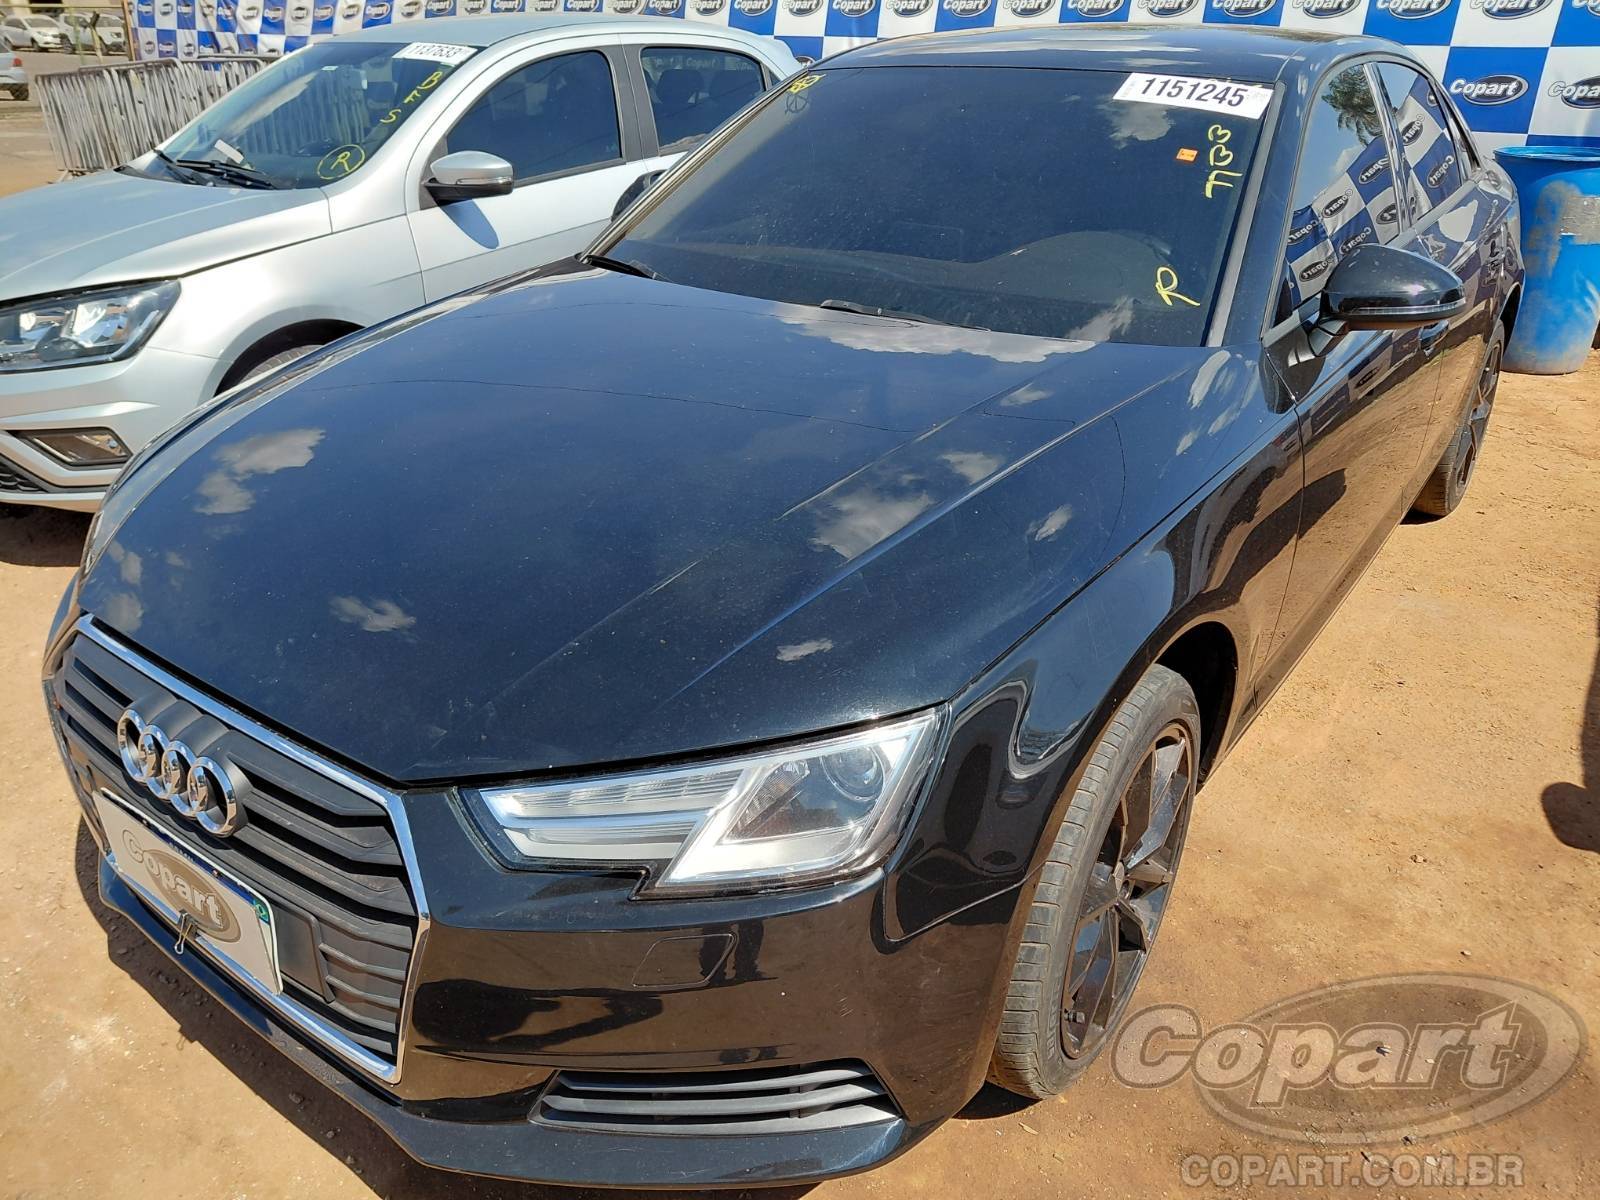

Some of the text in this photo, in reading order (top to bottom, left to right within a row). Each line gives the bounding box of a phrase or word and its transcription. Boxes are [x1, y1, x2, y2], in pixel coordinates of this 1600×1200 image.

[1141, 78, 1248, 107] 1151245
[1451, 79, 1520, 98] Copart
[1549, 81, 1600, 101] Copa
[1155, 266, 1200, 306] R
